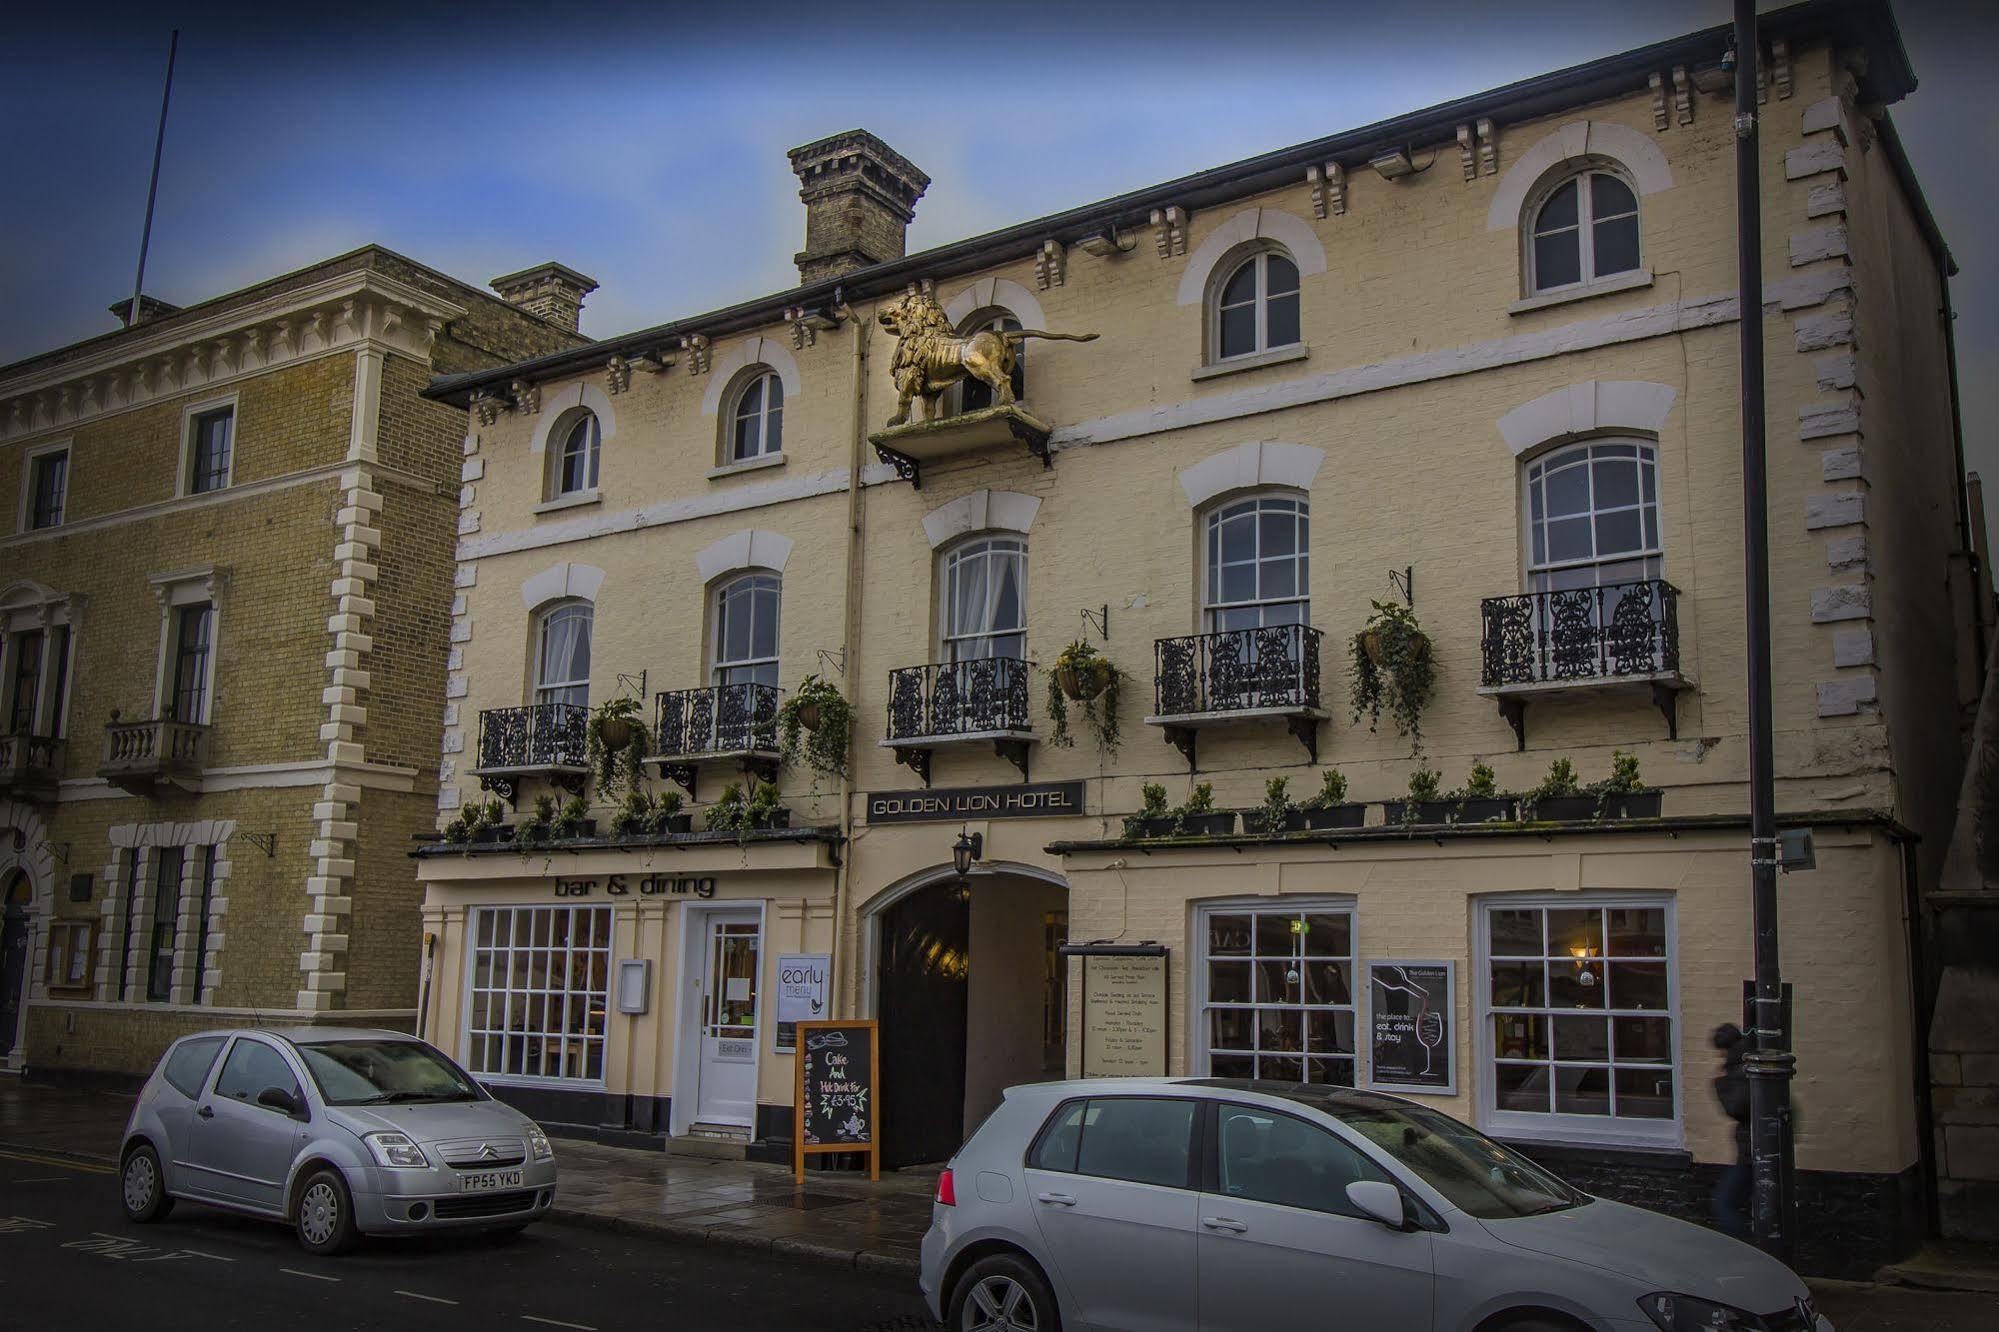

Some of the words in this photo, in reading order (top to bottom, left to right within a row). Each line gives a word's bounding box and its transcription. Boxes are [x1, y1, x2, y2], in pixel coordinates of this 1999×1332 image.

[873, 797, 950, 815] GOLDEN
[955, 794, 1000, 812] LION
[1006, 791, 1073, 809] HOTEL
[555, 877, 597, 897] bar
[607, 874, 628, 895] &
[640, 872, 716, 898] dining
[782, 964, 823, 996] early
[1394, 1022, 1414, 1031] drink
[1376, 1032, 1383, 1041] &
[1385, 1033, 1402, 1043] stay
[825, 1051, 849, 1066] Cake
[829, 1066, 846, 1079] And
[820, 1080, 833, 1093] Hot
[834, 1081, 850, 1093] Drink
[465, 1174, 496, 1189] FP55
[499, 1171, 521, 1186] YKD
